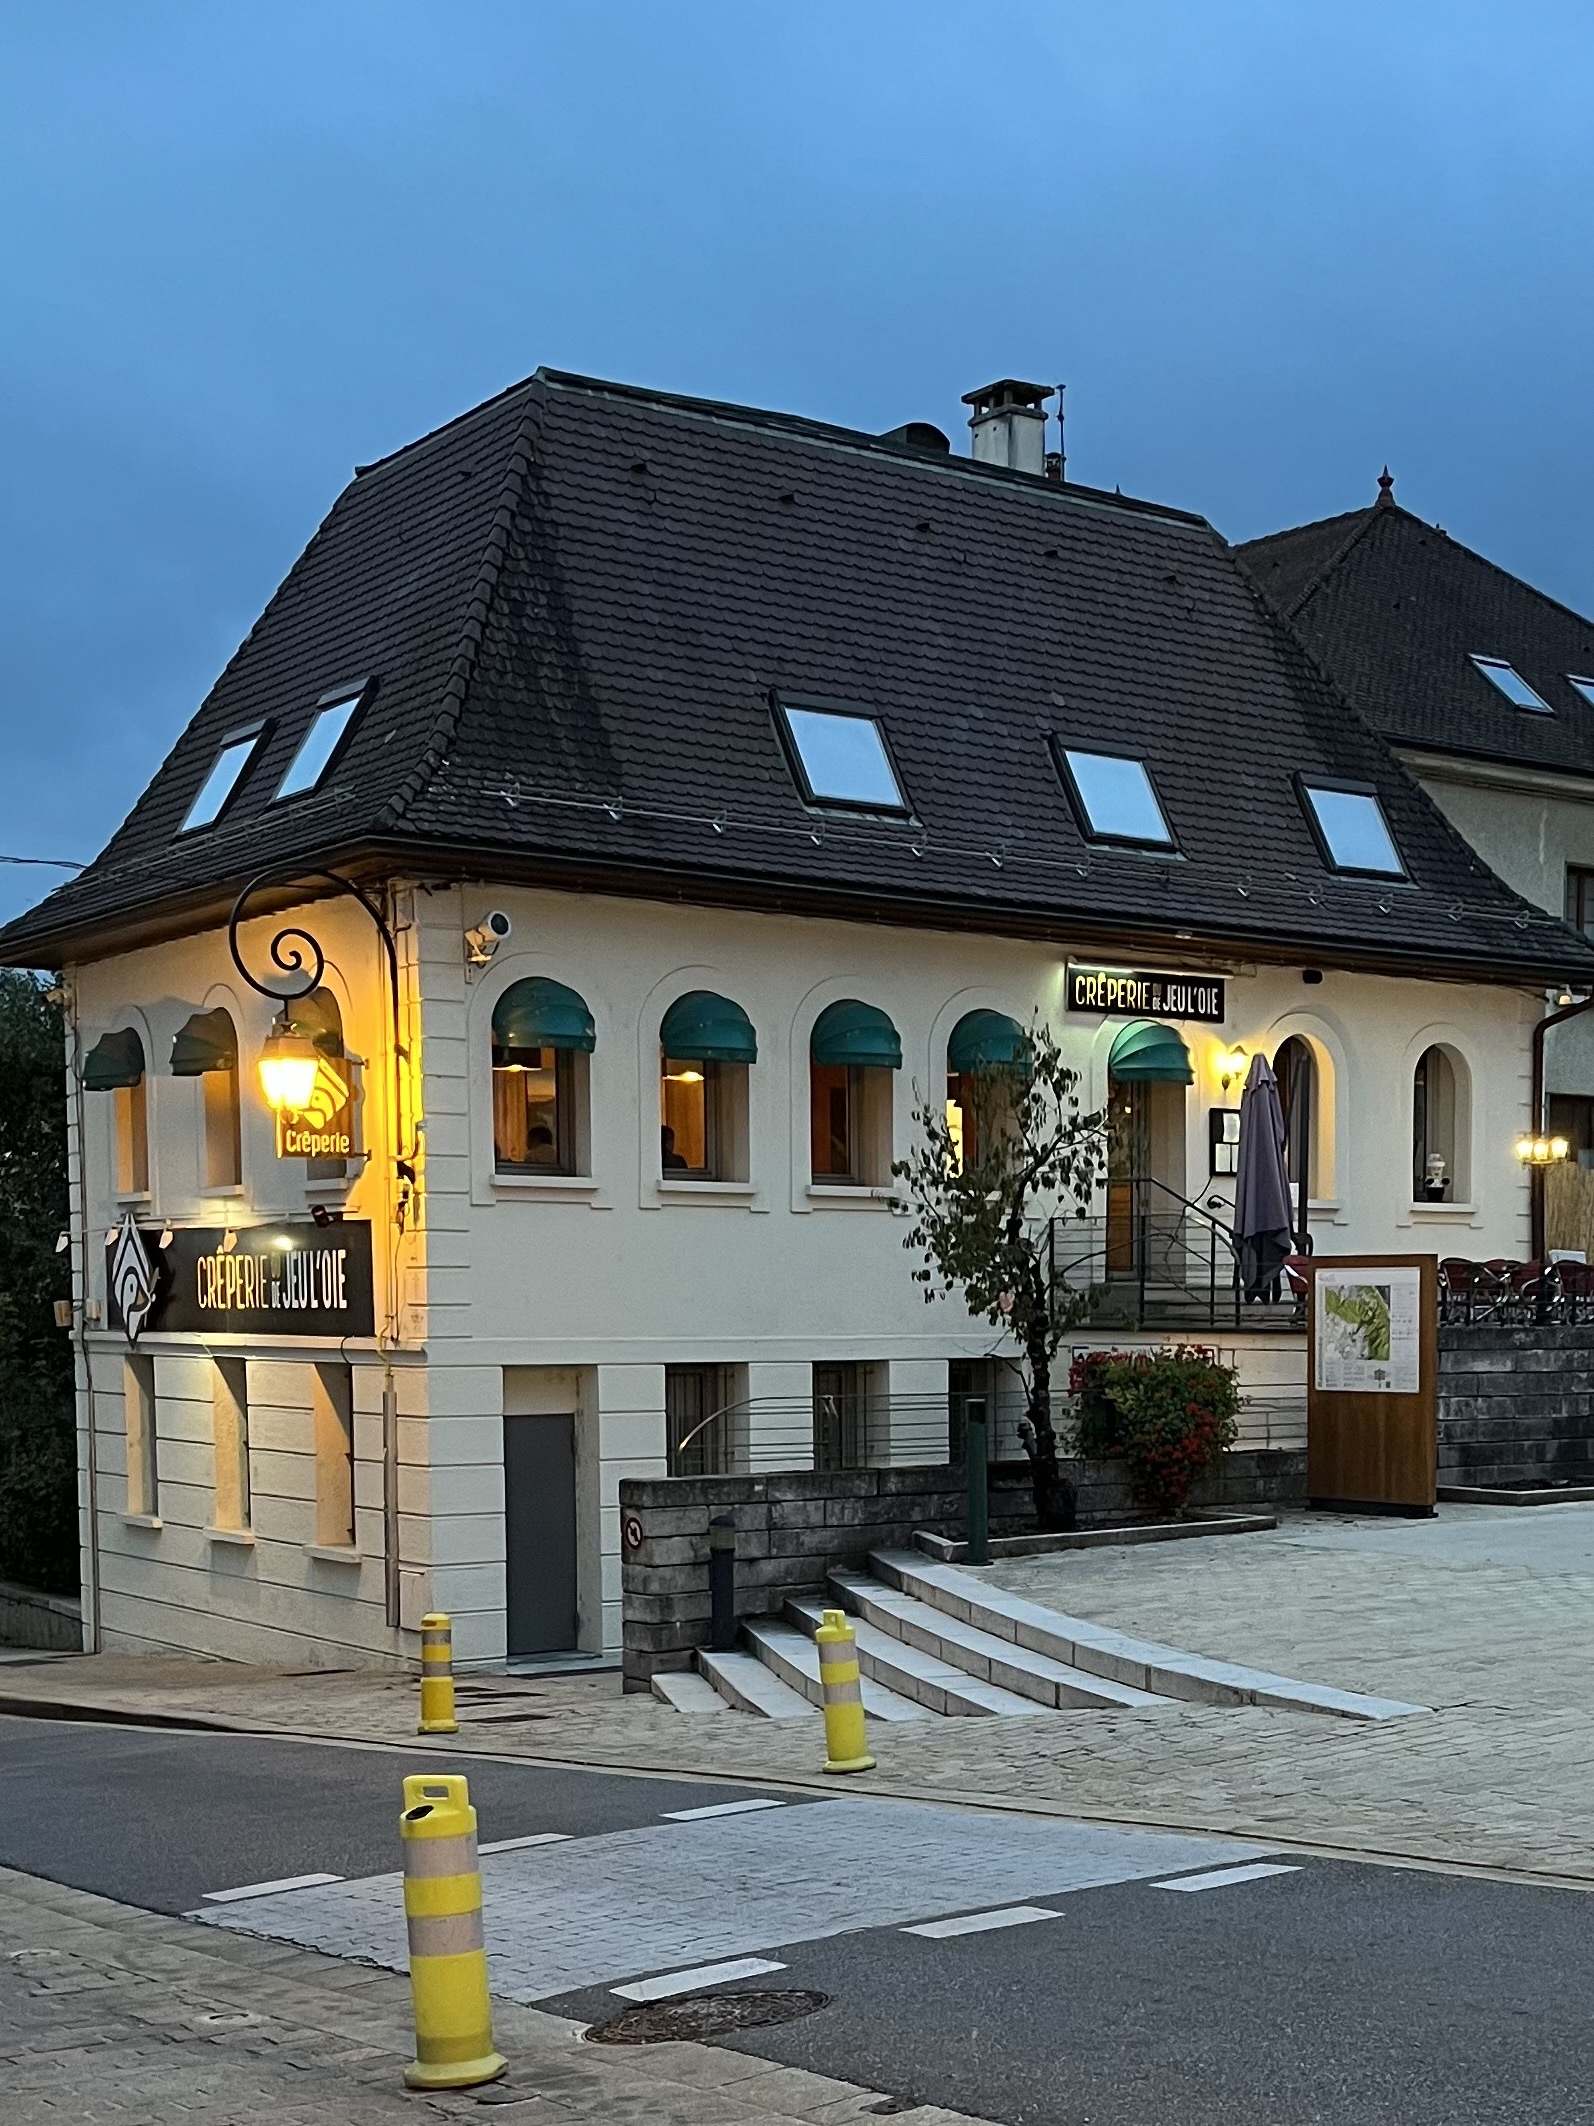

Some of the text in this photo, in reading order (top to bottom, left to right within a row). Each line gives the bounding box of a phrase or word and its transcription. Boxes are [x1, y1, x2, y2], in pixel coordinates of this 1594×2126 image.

[1075, 972, 1150, 1009] CRÊPERIE
[1163, 984, 1185, 1012] JEU
[1187, 986, 1219, 1015] L'OIE
[286, 1130, 350, 1157] Crêperie
[197, 1244, 269, 1309] CRÊPERIE
[282, 1250, 307, 1309] JEU
[309, 1249, 348, 1309] L'OIE
